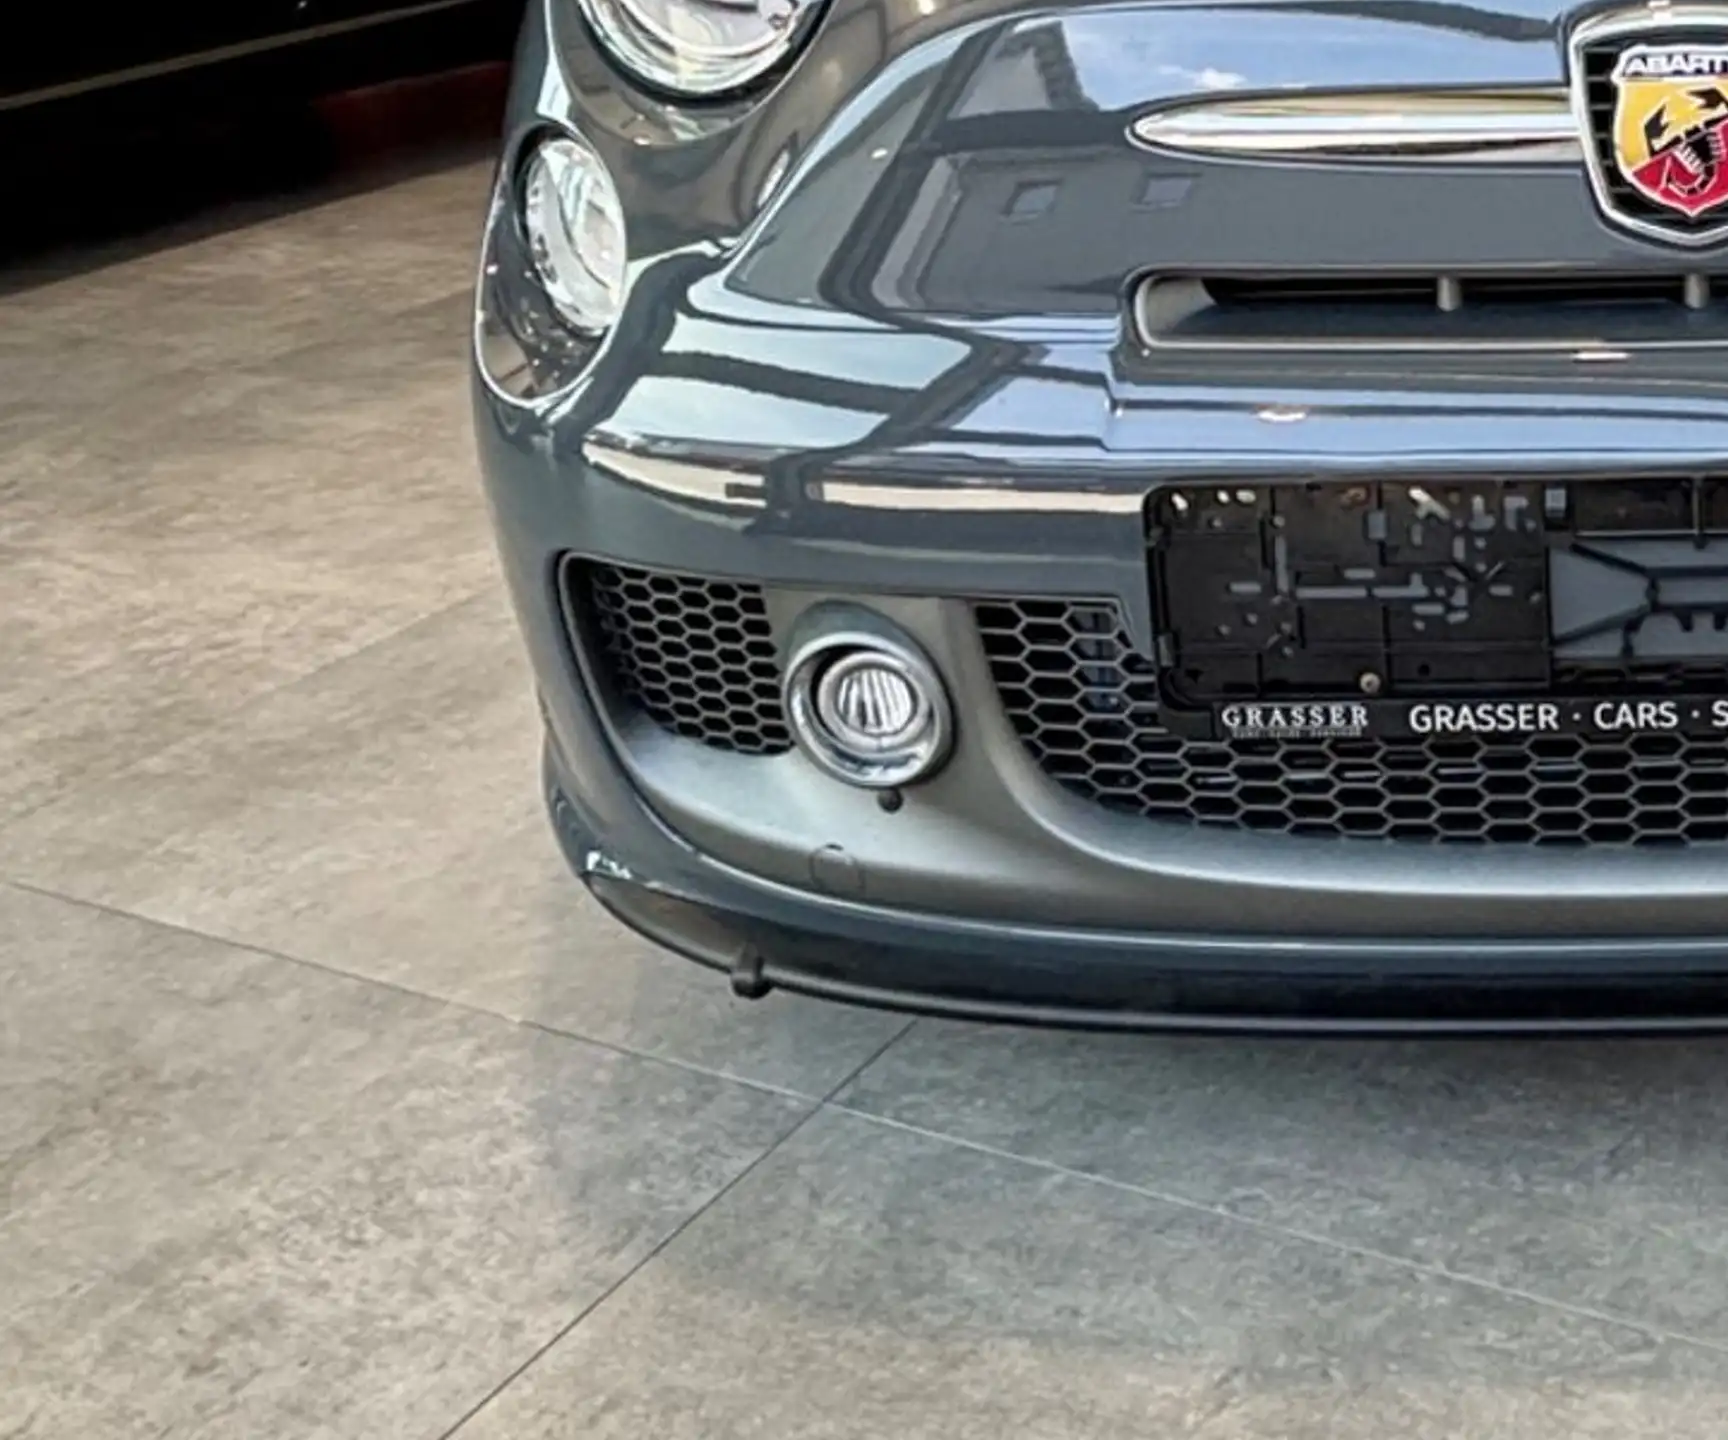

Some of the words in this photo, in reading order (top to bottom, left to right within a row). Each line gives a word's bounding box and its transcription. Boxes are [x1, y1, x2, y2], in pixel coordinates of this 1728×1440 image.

[1221, 704, 1369, 728] GRASSER
[1408, 703, 1560, 733] GRASSER
[1593, 701, 1679, 729] CARS
